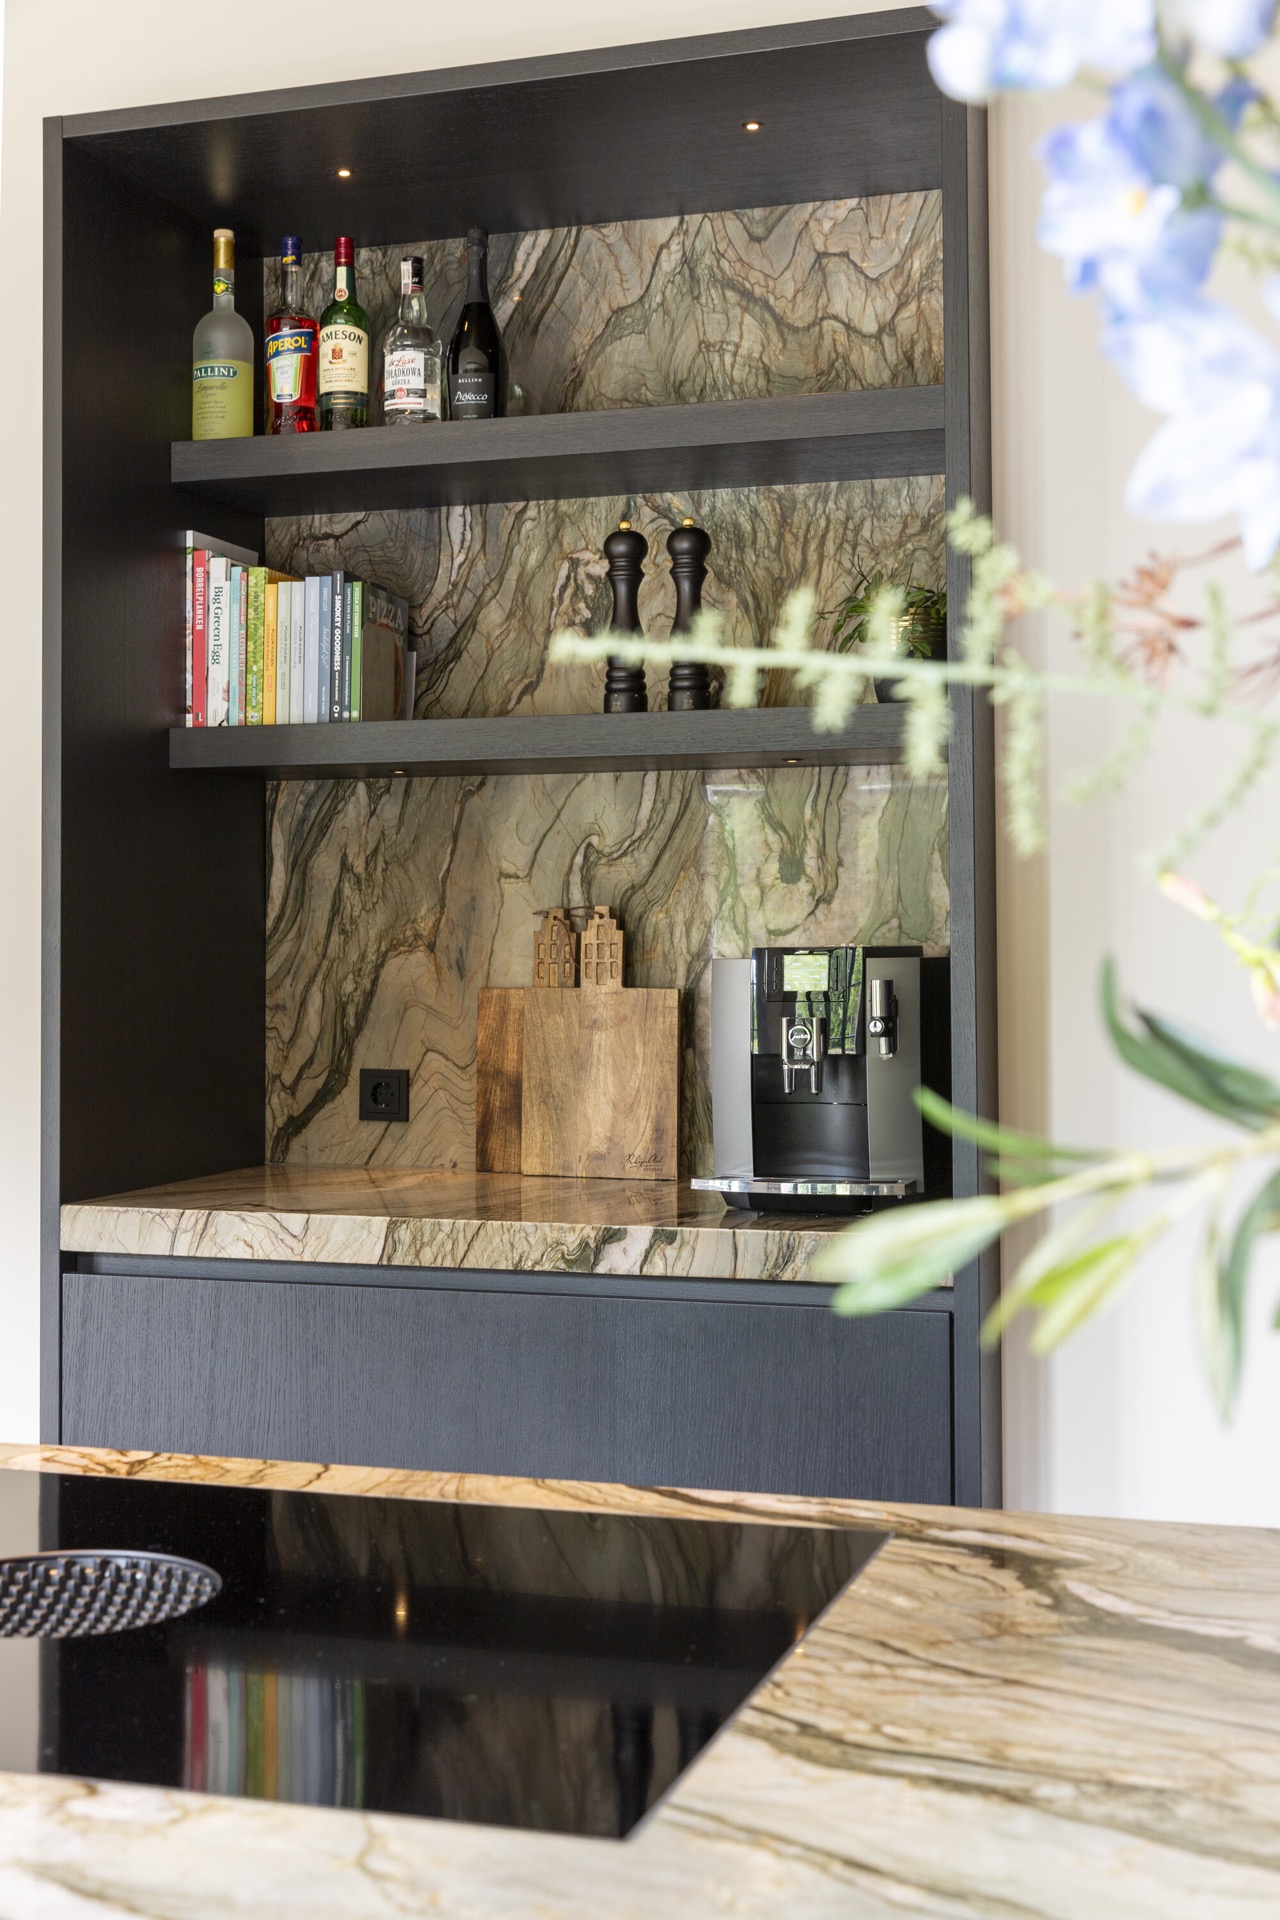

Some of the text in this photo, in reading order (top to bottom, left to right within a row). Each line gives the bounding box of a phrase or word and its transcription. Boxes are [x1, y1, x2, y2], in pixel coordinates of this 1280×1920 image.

[267, 336, 307, 356] APEROL
[193, 367, 234, 378] PALLINI
[453, 390, 488, 405] Prosecco
[195, 567, 204, 630] BORRELPLANKEN
[212, 586, 223, 604] Big
[213, 606, 223, 642] Green
[369, 595, 404, 632] PIZZA
[211, 643, 222, 665] Egg
